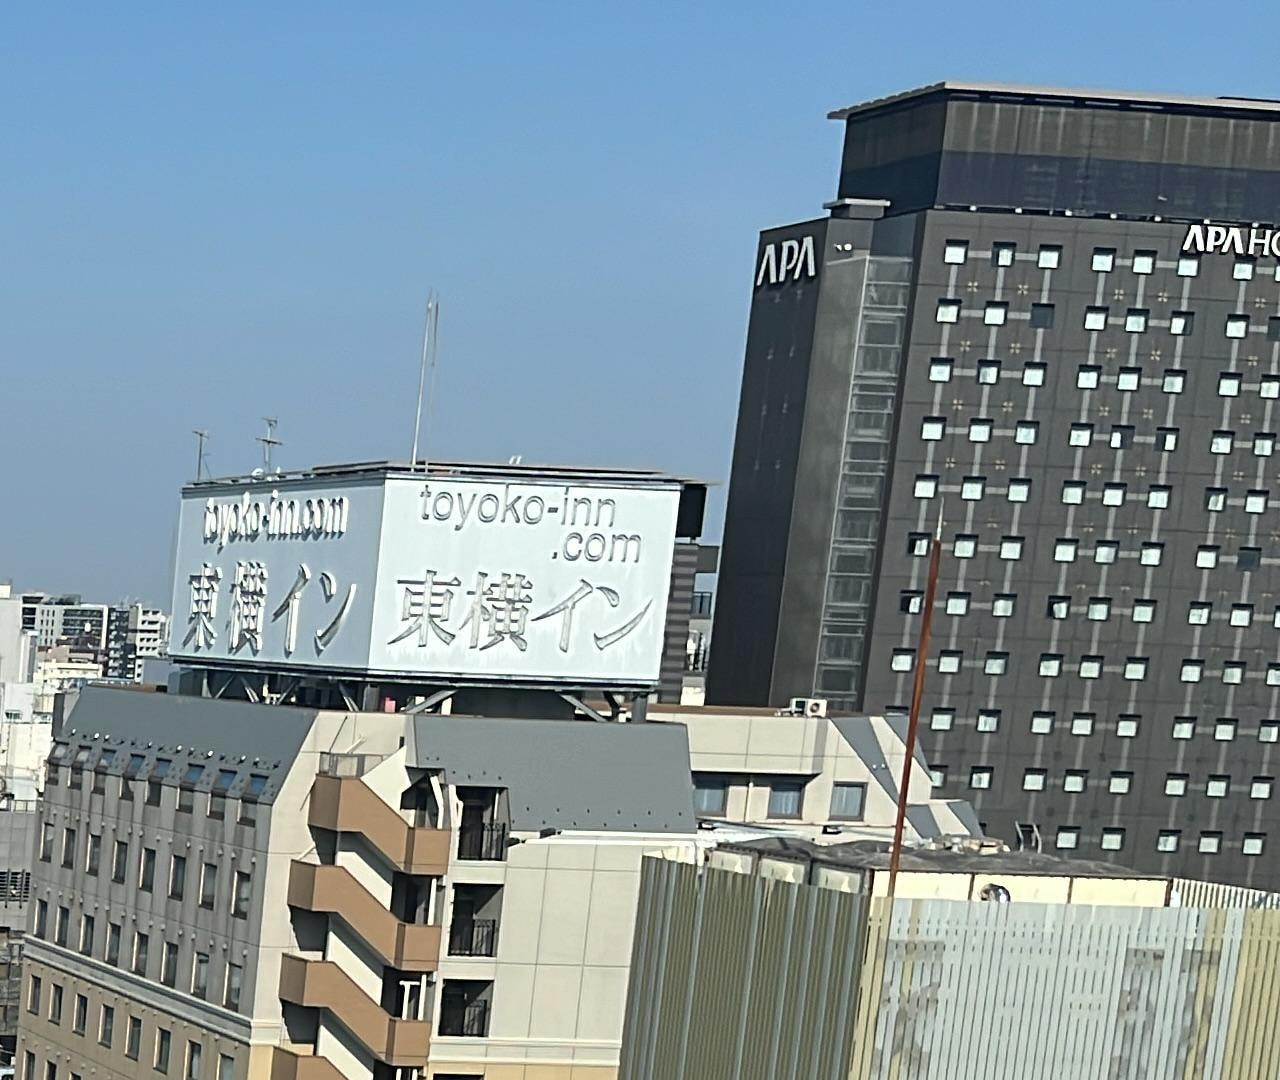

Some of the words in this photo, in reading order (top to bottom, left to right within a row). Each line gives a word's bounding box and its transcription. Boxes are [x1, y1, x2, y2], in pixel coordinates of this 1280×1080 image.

[756, 235, 816, 287] APA
[1182, 225, 1244, 255] APA
[420, 484, 617, 531] toyoko-inn
[183, 561, 357, 654] 東横イン
[387, 569, 654, 653] 東横イン
